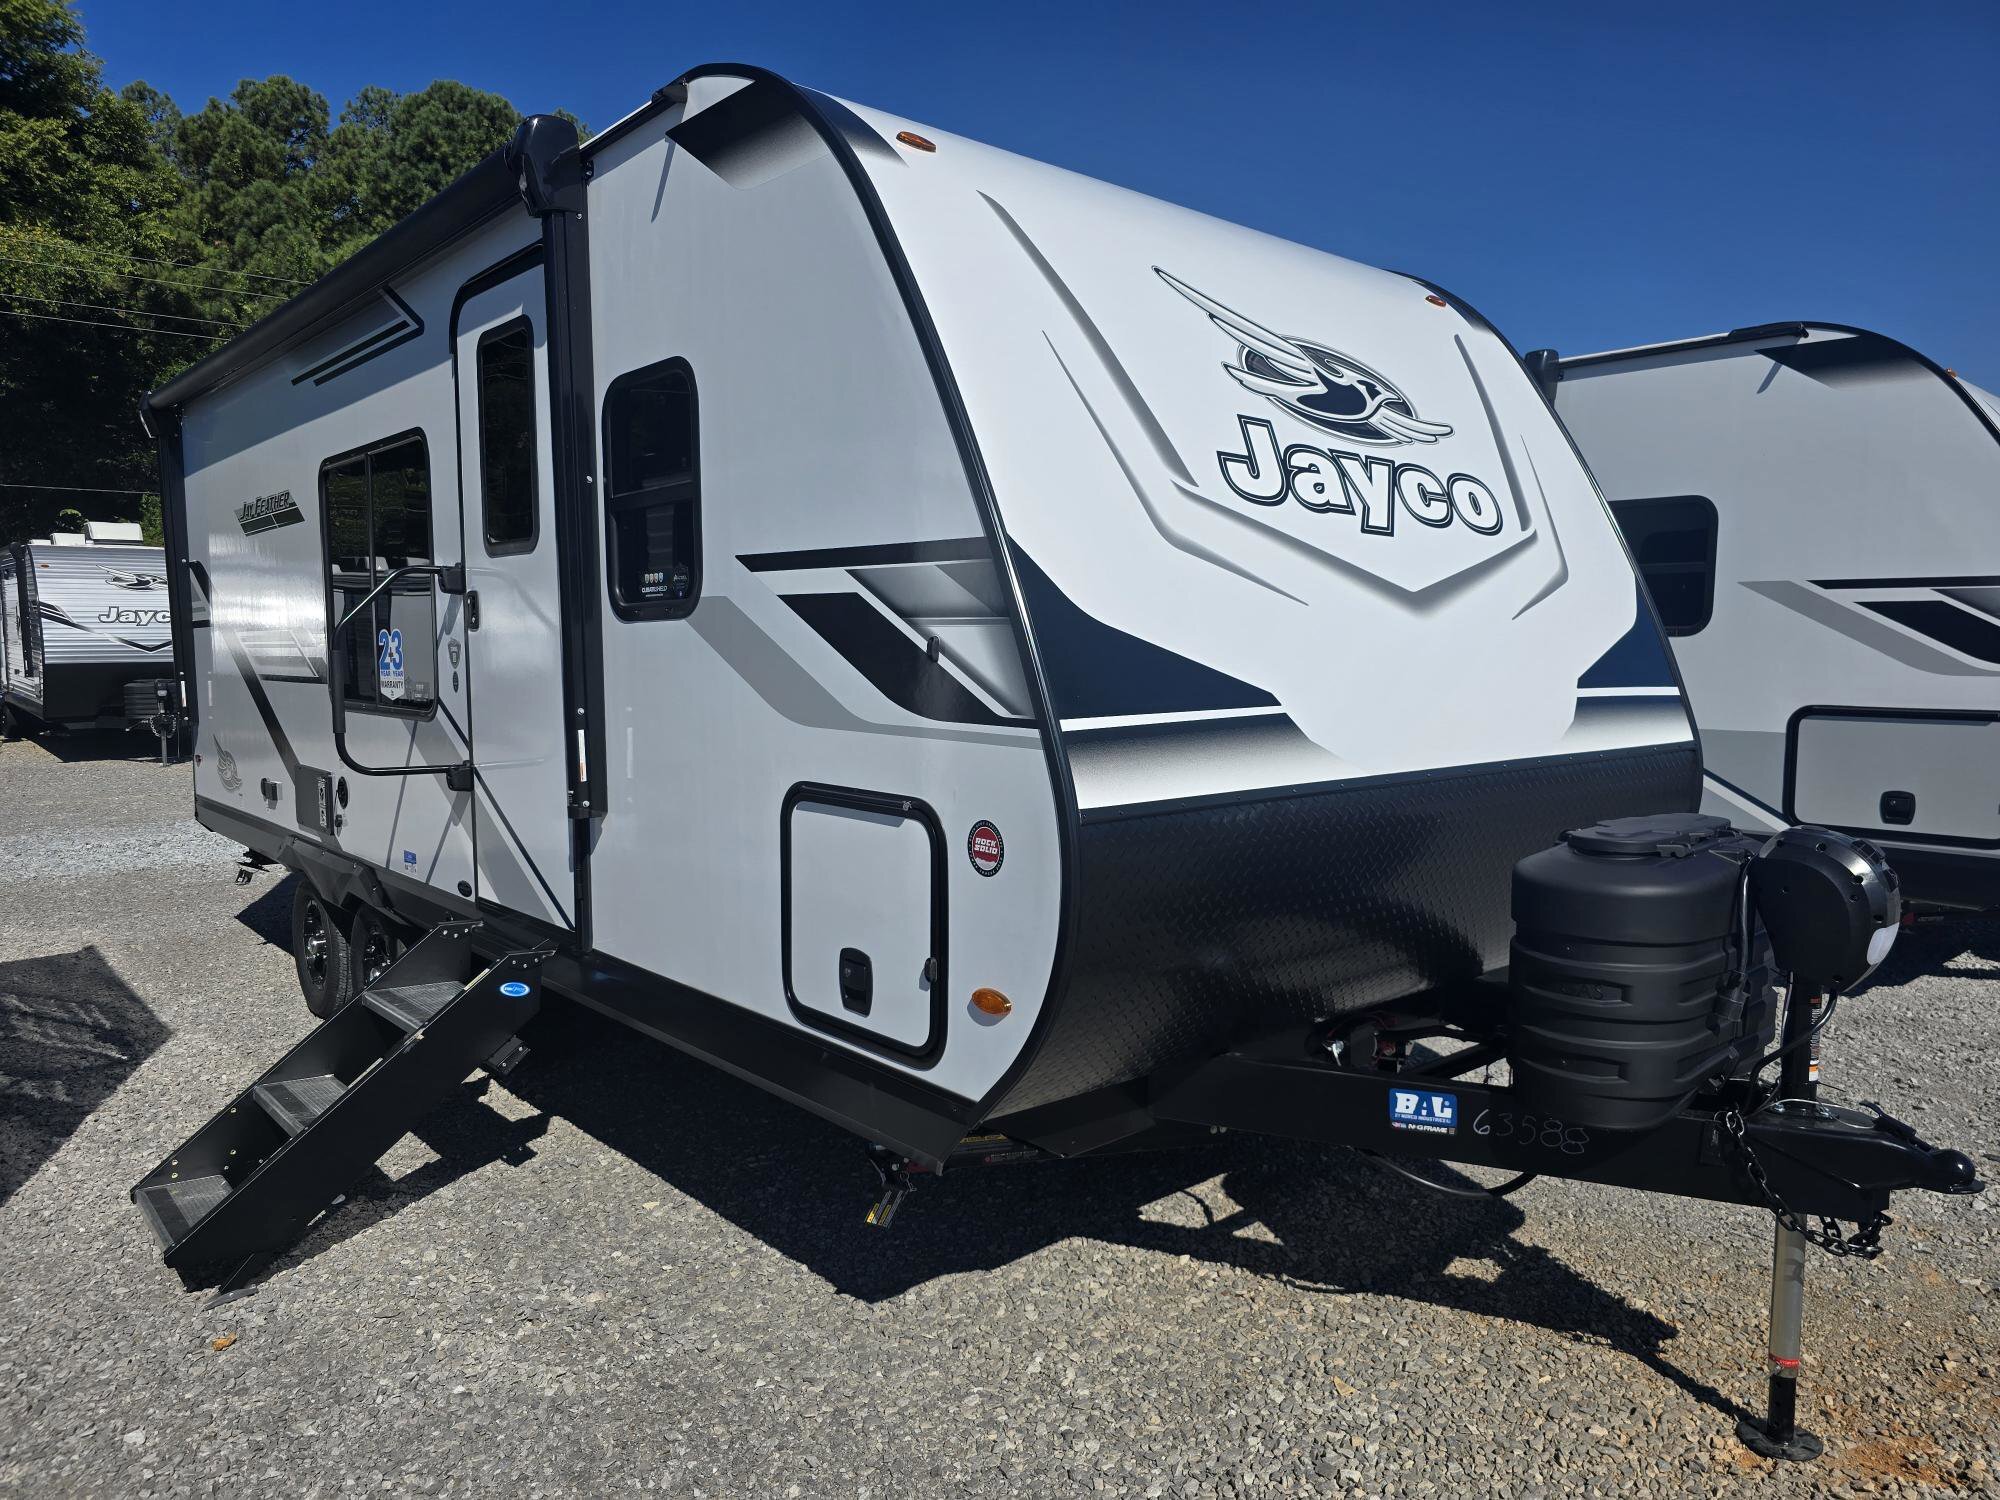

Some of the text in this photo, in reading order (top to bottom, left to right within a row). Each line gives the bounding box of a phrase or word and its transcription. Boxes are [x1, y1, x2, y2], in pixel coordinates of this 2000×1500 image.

[1216, 414, 1504, 537] Jayco
[255, 490, 290, 515] FEATHER
[98, 606, 171, 626] Jayc
[380, 680, 404, 689] WARRANTY
[974, 845, 998, 854] SOLID
[975, 837, 997, 848] ROCK
[1394, 1092, 1453, 1118] BAL
